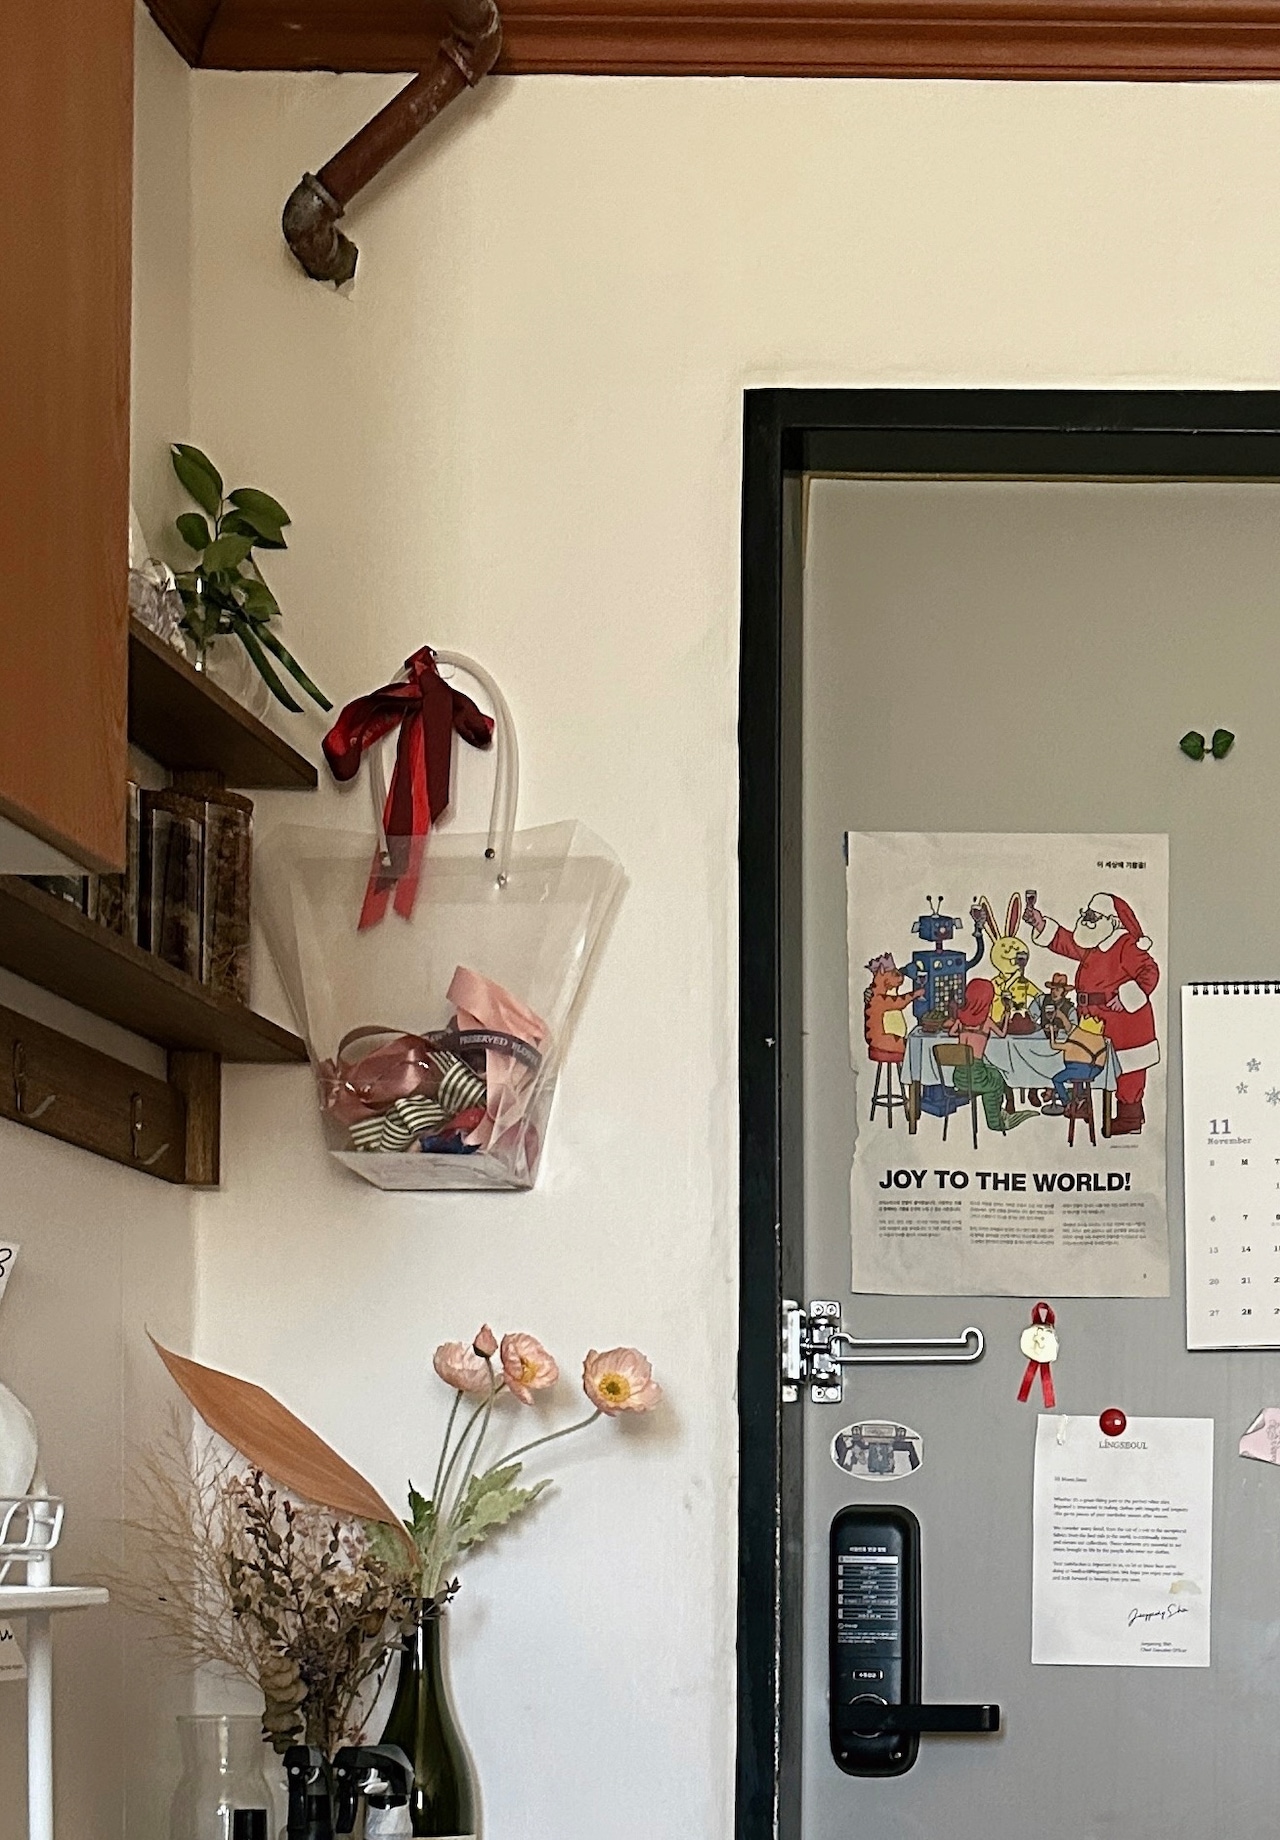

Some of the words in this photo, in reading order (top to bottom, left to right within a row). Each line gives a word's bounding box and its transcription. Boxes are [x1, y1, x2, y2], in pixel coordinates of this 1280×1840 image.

[460, 1034, 508, 1047] PRESERVED
[1209, 1119, 1232, 1135] 11
[1207, 1137, 1252, 1145] November
[879, 1170, 927, 1189] JOY
[934, 1170, 969, 1189] TO
[976, 1172, 1027, 1191] THE
[1033, 1172, 1131, 1192] WORLD!
